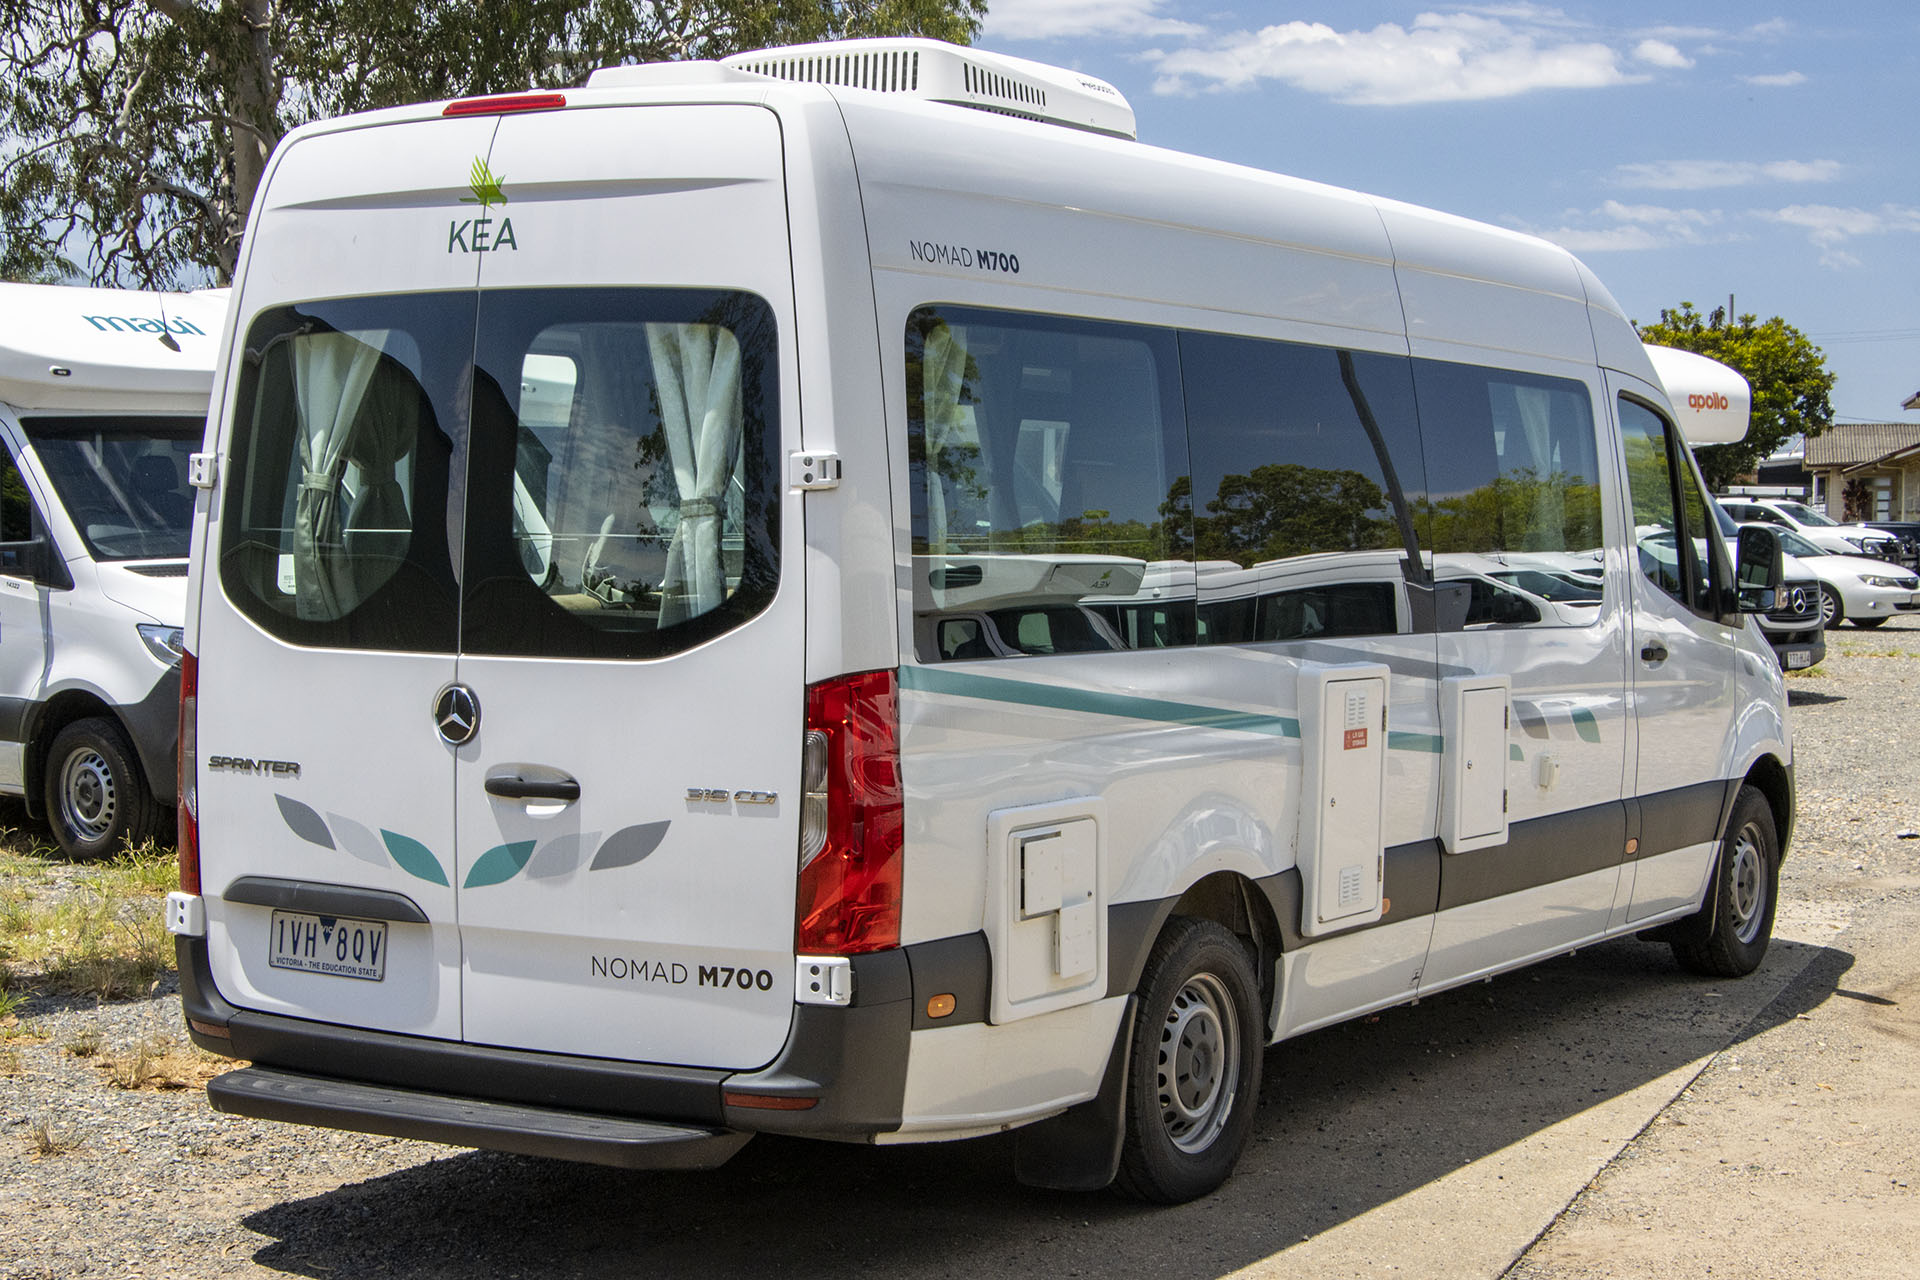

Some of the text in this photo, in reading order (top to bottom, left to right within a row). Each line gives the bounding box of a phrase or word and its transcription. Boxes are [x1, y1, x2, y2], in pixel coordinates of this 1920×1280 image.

[448, 217, 518, 253] KEA
[910, 240, 1020, 274] NOMAD M700
[81, 315, 207, 336] maui
[1688, 391, 1729, 413] apollo
[208, 755, 301, 775] SPRINTER
[279, 919, 382, 966] 1VH 8QV
[276, 956, 303, 968] VICTORIA
[308, 961, 321, 970] THE
[321, 962, 357, 974] EDUCATION
[358, 967, 377, 977] STATE
[591, 955, 774, 991] NOMAD M700
